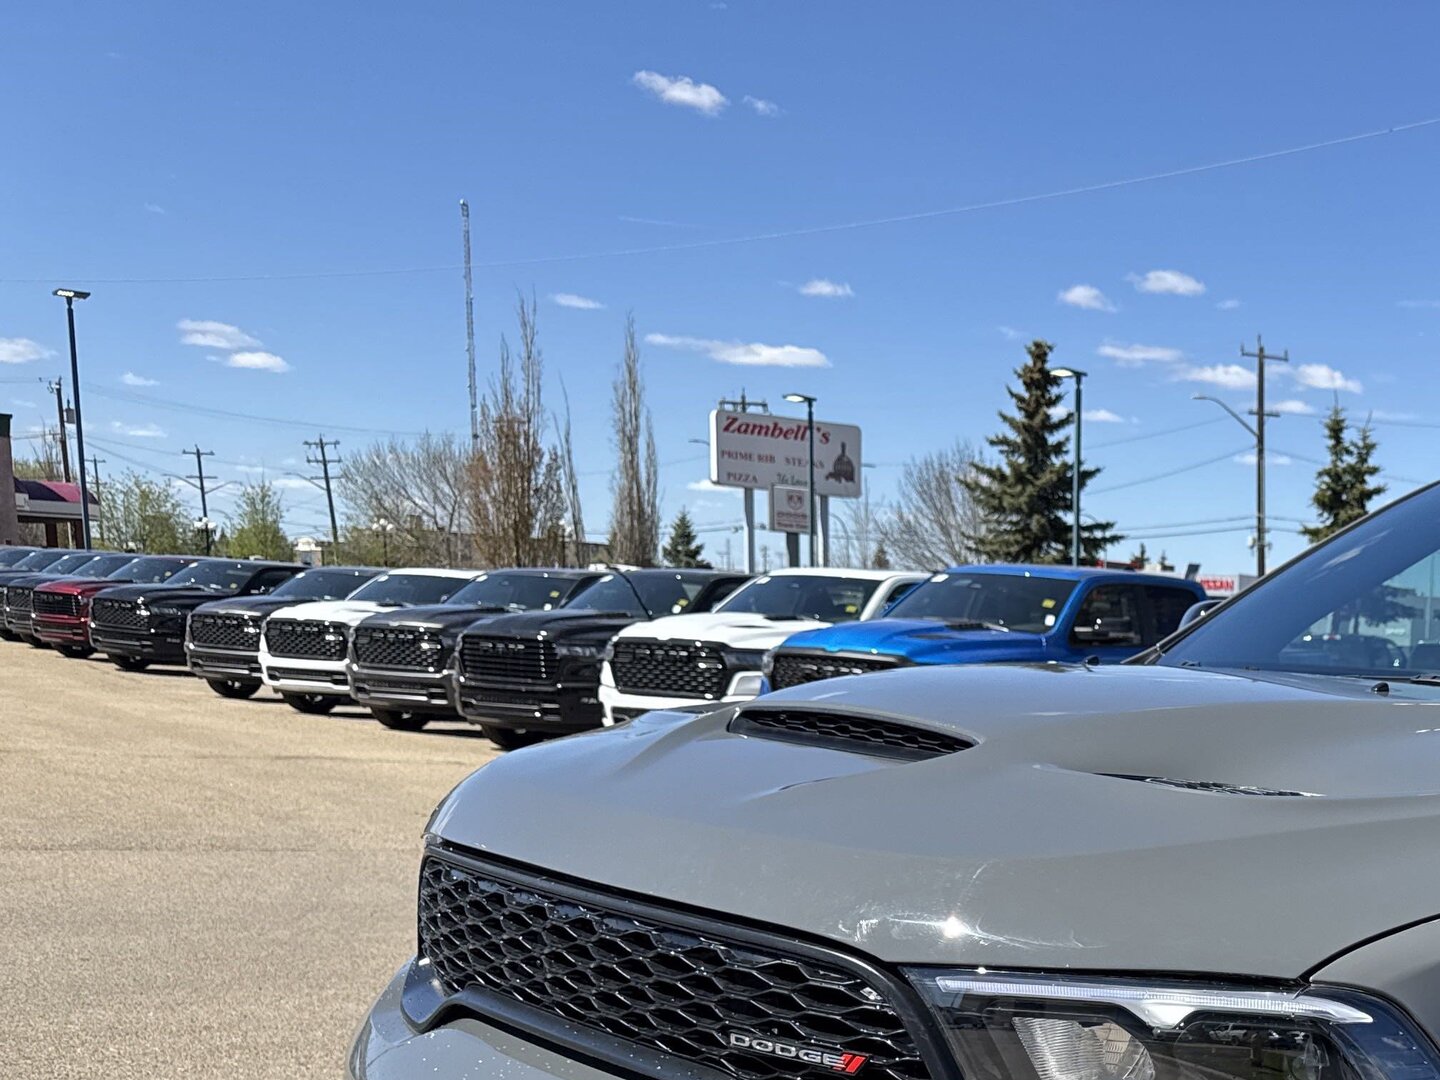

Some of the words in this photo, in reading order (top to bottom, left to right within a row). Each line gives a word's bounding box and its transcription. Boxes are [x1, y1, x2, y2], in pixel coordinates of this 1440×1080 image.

[722, 415, 831, 445] Zambell's
[720, 449, 755, 462] PRIME
[756, 454, 776, 464] RIB
[727, 472, 758, 483] PIZZA
[729, 1032, 847, 1069] DODGE
